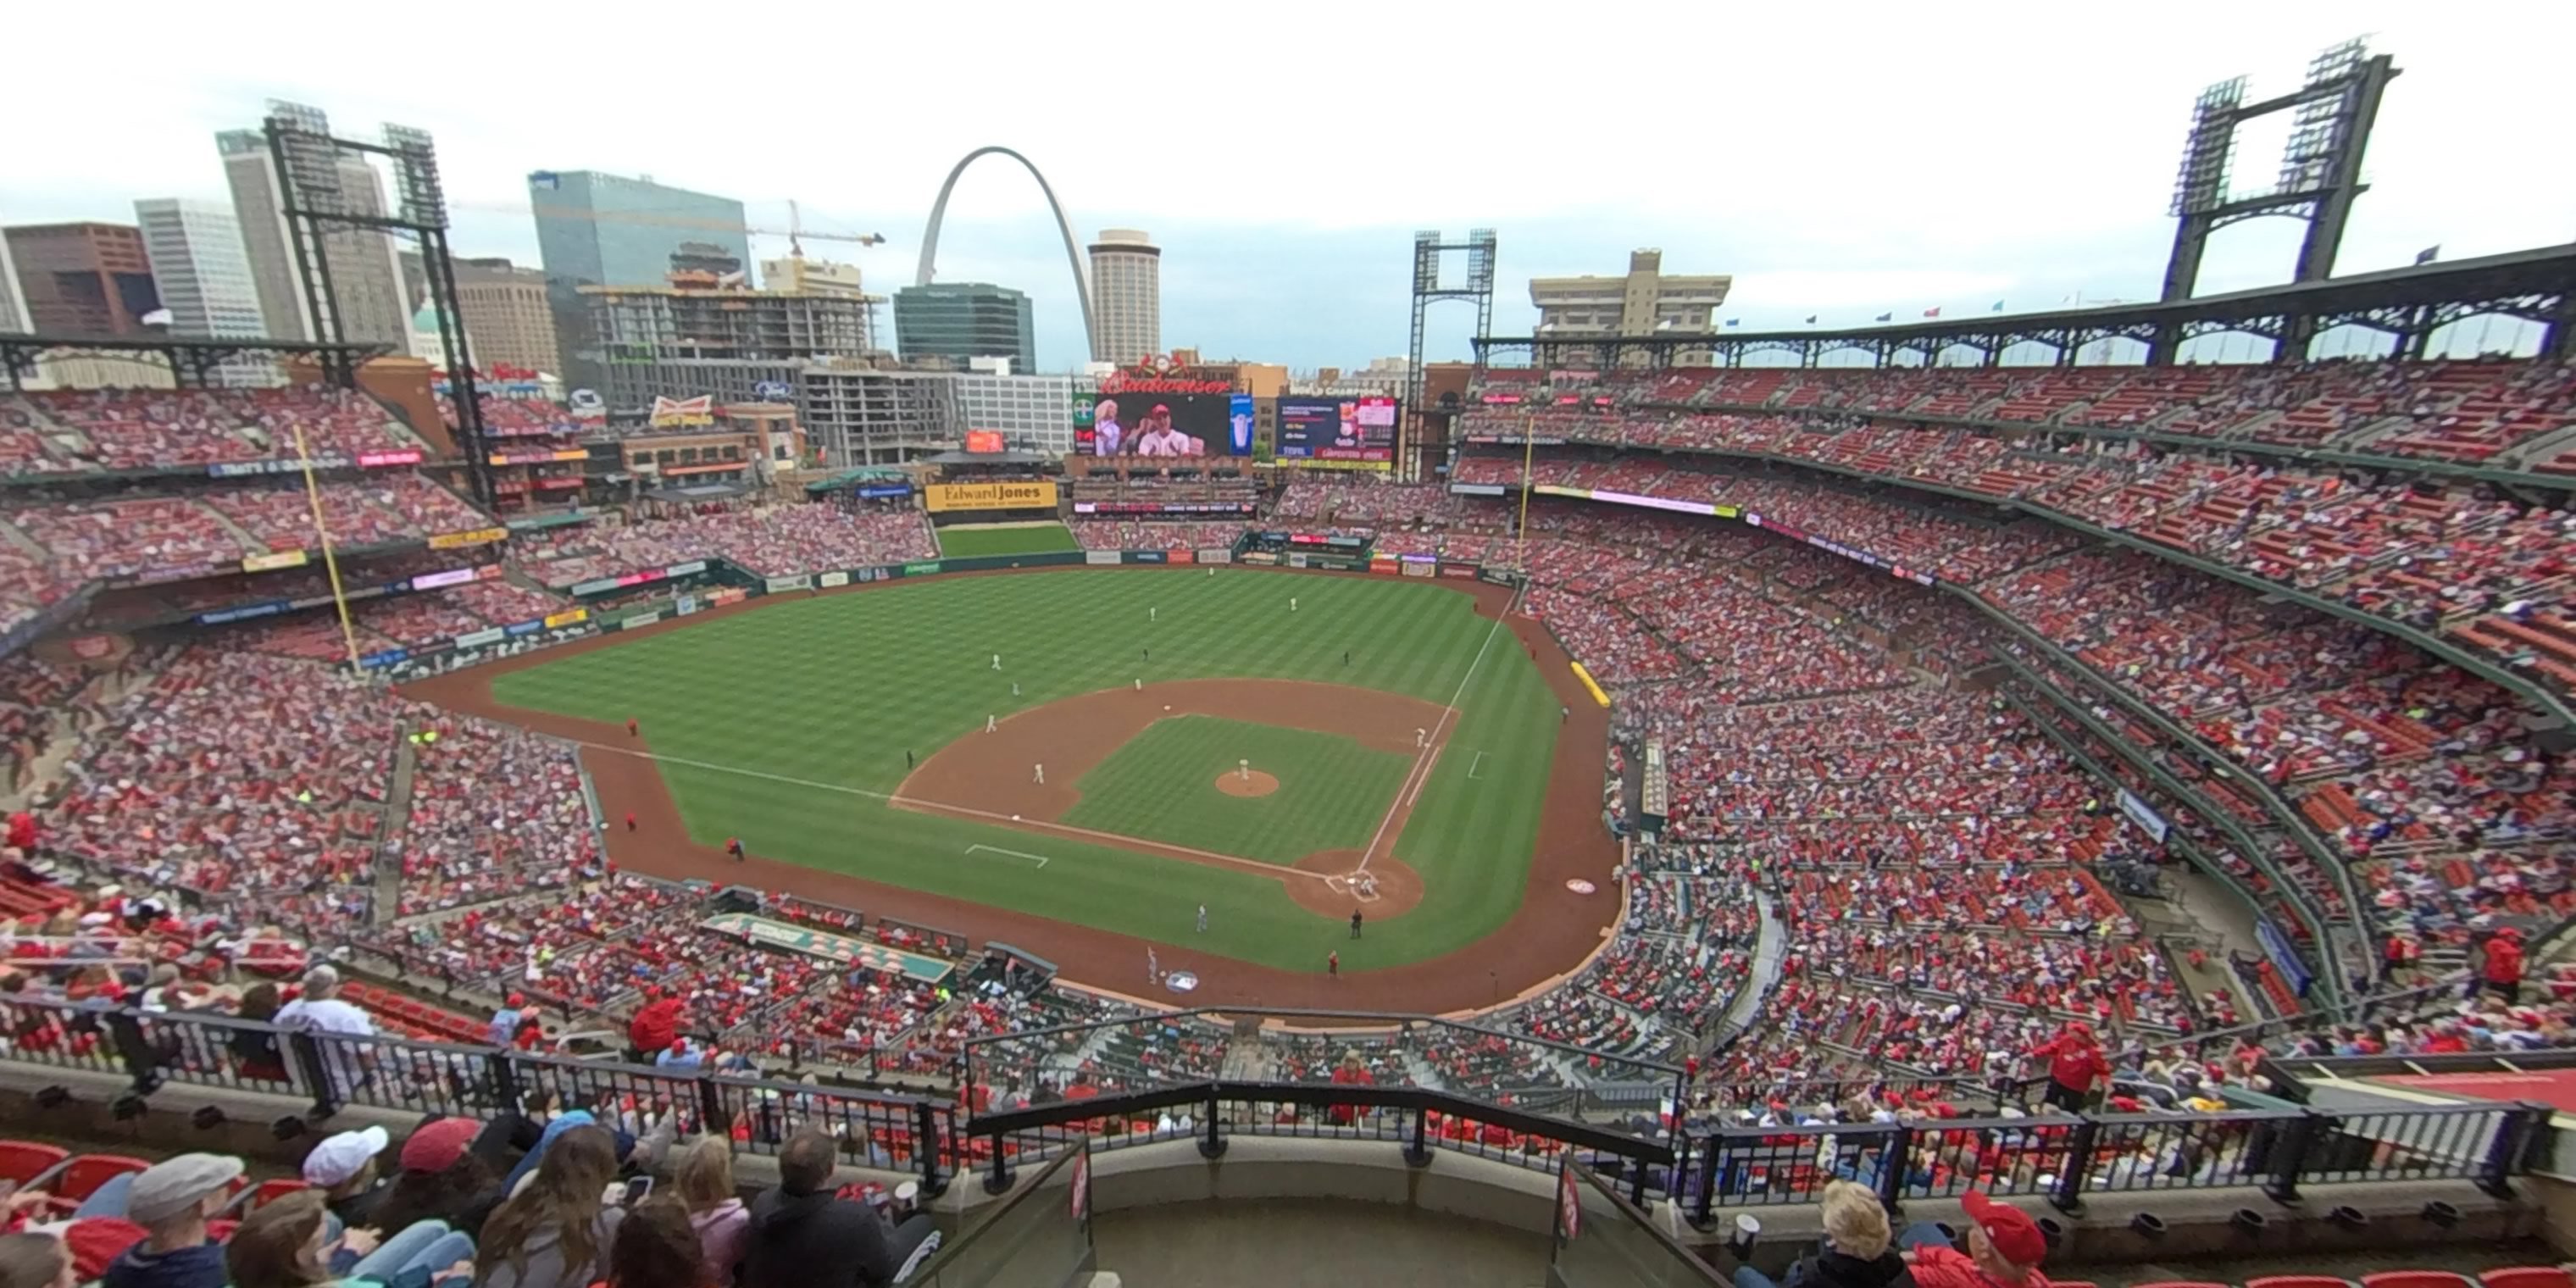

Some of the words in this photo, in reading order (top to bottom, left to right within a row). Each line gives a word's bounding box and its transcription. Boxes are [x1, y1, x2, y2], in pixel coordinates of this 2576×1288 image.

[1101, 369, 1230, 393] Budweiser
[945, 486, 997, 500] Edward
[998, 485, 1041, 500] Jones
